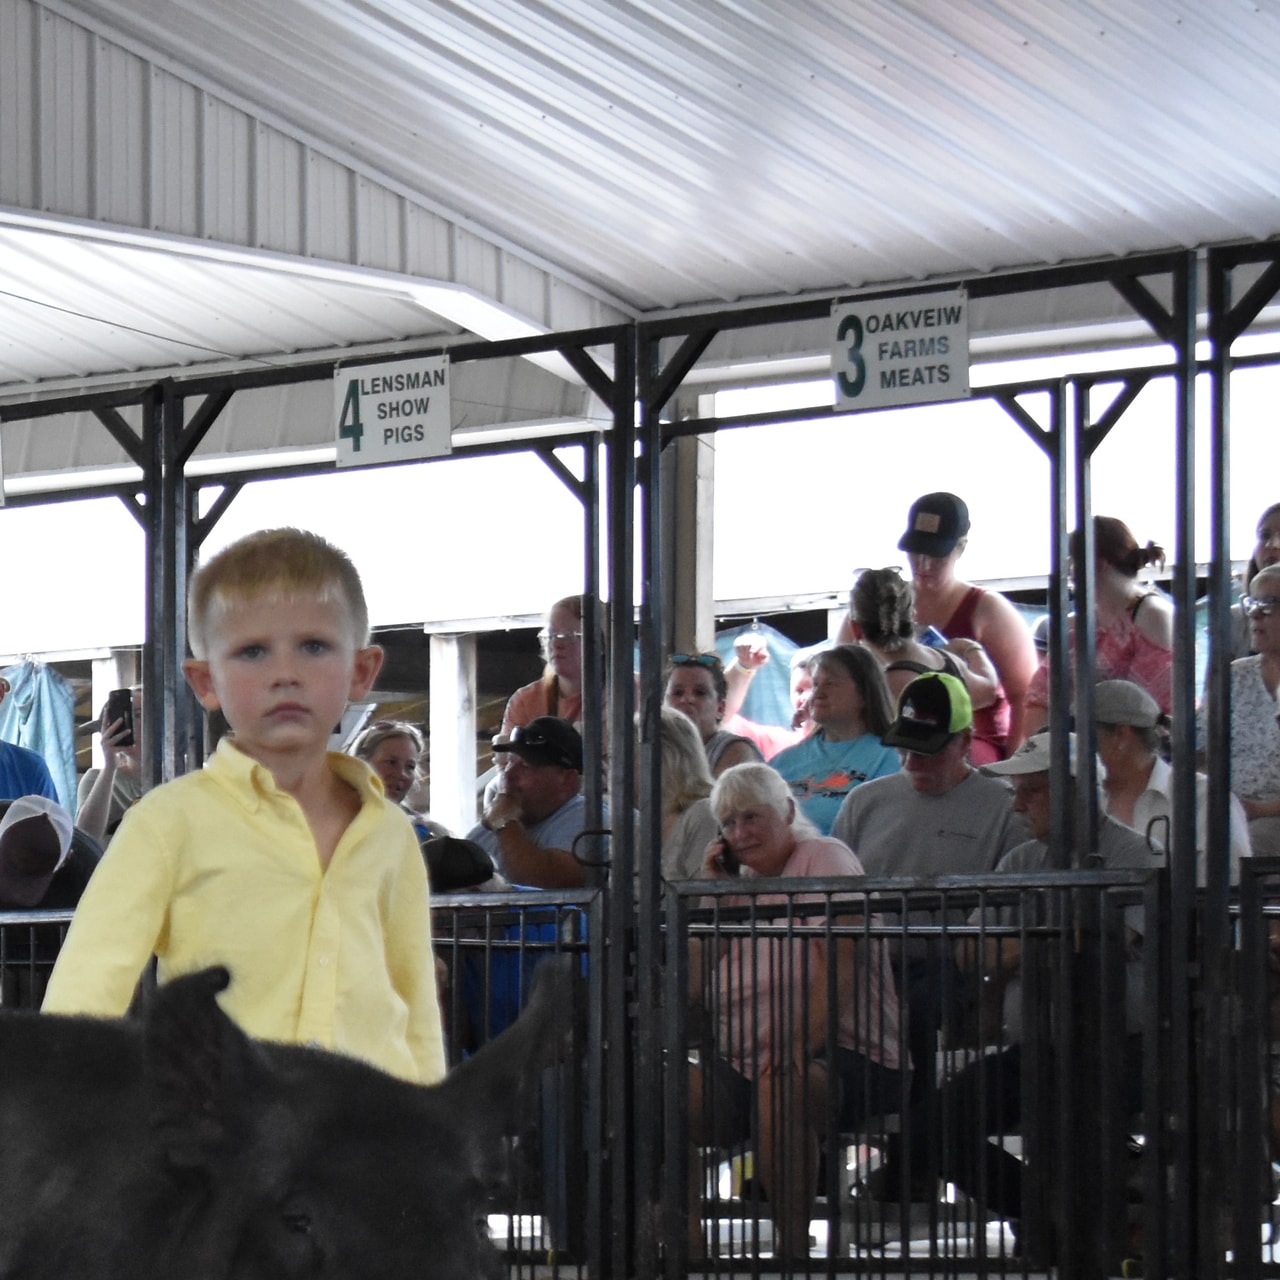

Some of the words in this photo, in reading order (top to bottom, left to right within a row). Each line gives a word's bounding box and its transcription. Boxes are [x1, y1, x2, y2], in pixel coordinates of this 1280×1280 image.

[866, 305, 962, 333] OAKVEIW
[837, 314, 866, 398] 3
[878, 336, 949, 361] FARMS
[361, 368, 445, 396] LENSMAN
[880, 364, 950, 389] MEATS
[339, 379, 364, 452] 4
[377, 397, 430, 419] SHOW
[384, 424, 424, 445] PIGS
